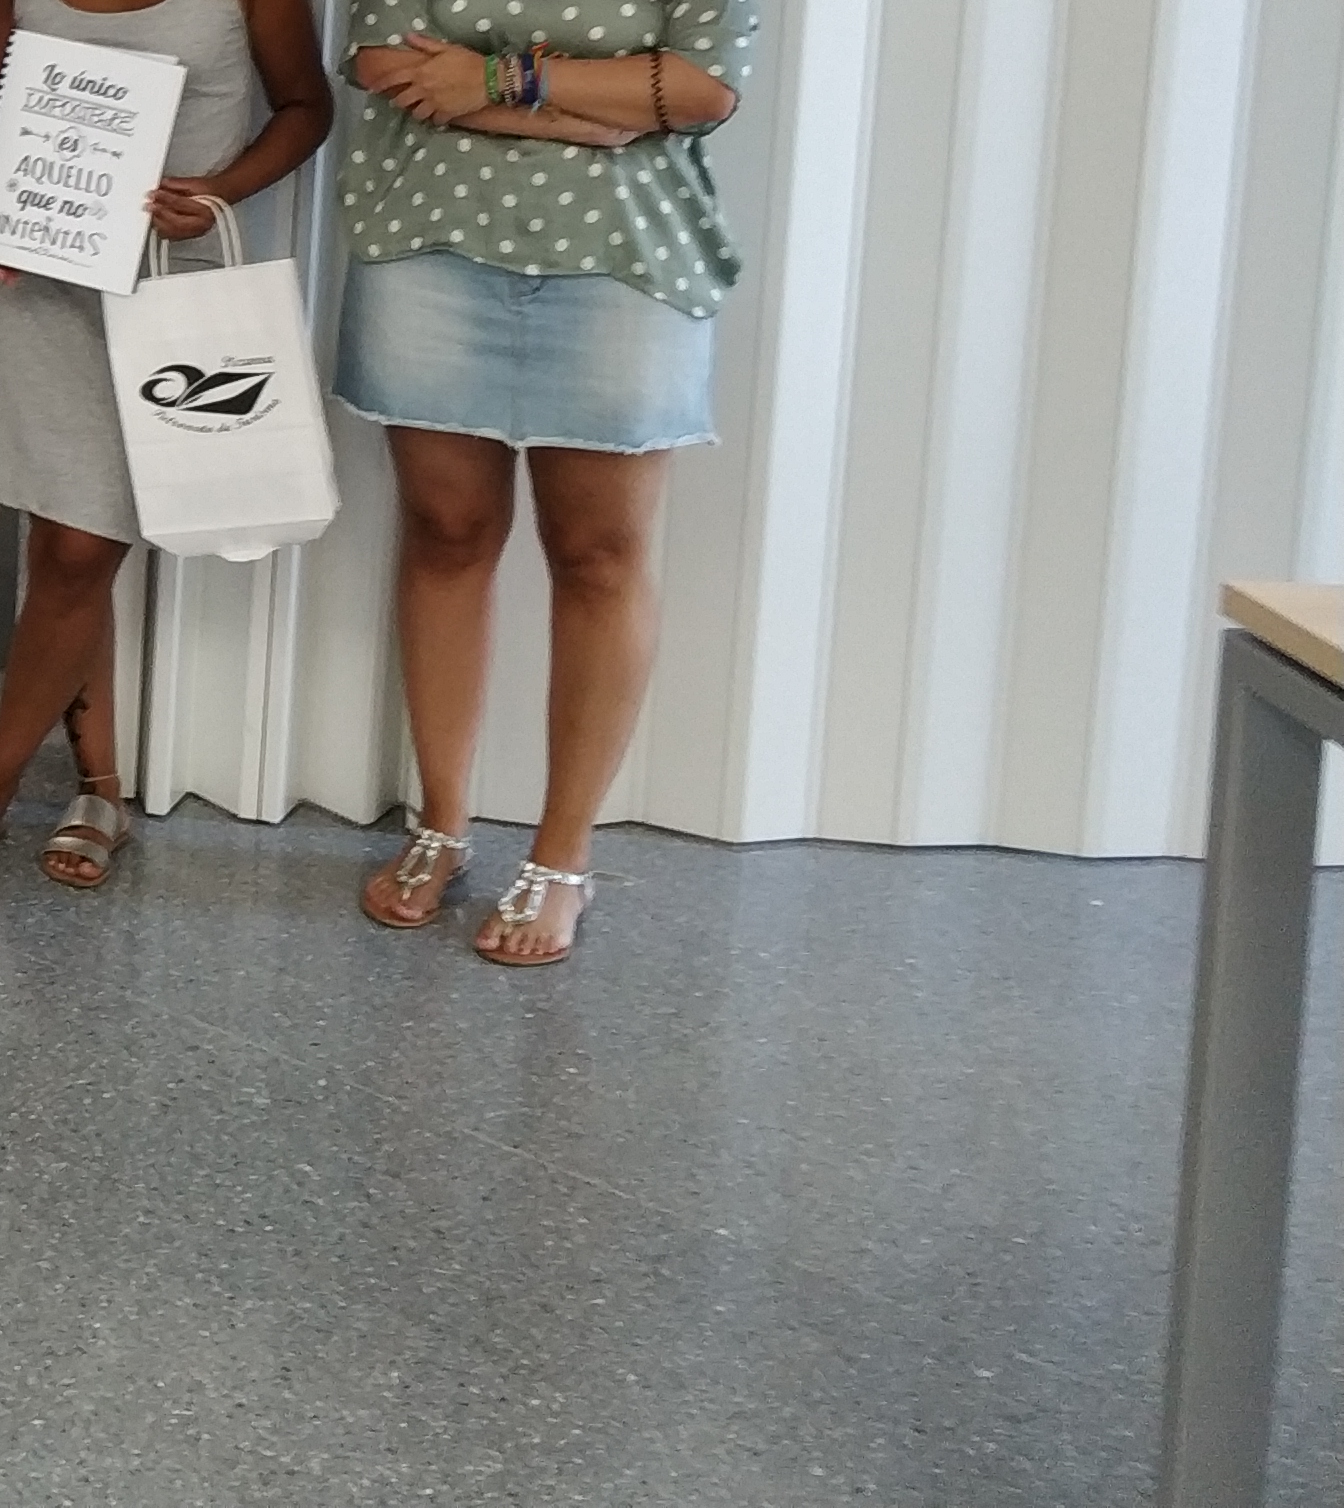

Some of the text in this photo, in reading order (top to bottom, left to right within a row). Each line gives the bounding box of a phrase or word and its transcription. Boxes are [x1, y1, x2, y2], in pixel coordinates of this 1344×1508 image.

[42, 63, 129, 101] Lo único
[58, 134, 79, 153] es
[13, 155, 113, 197] AQUELLO
[16, 189, 89, 219] que no
